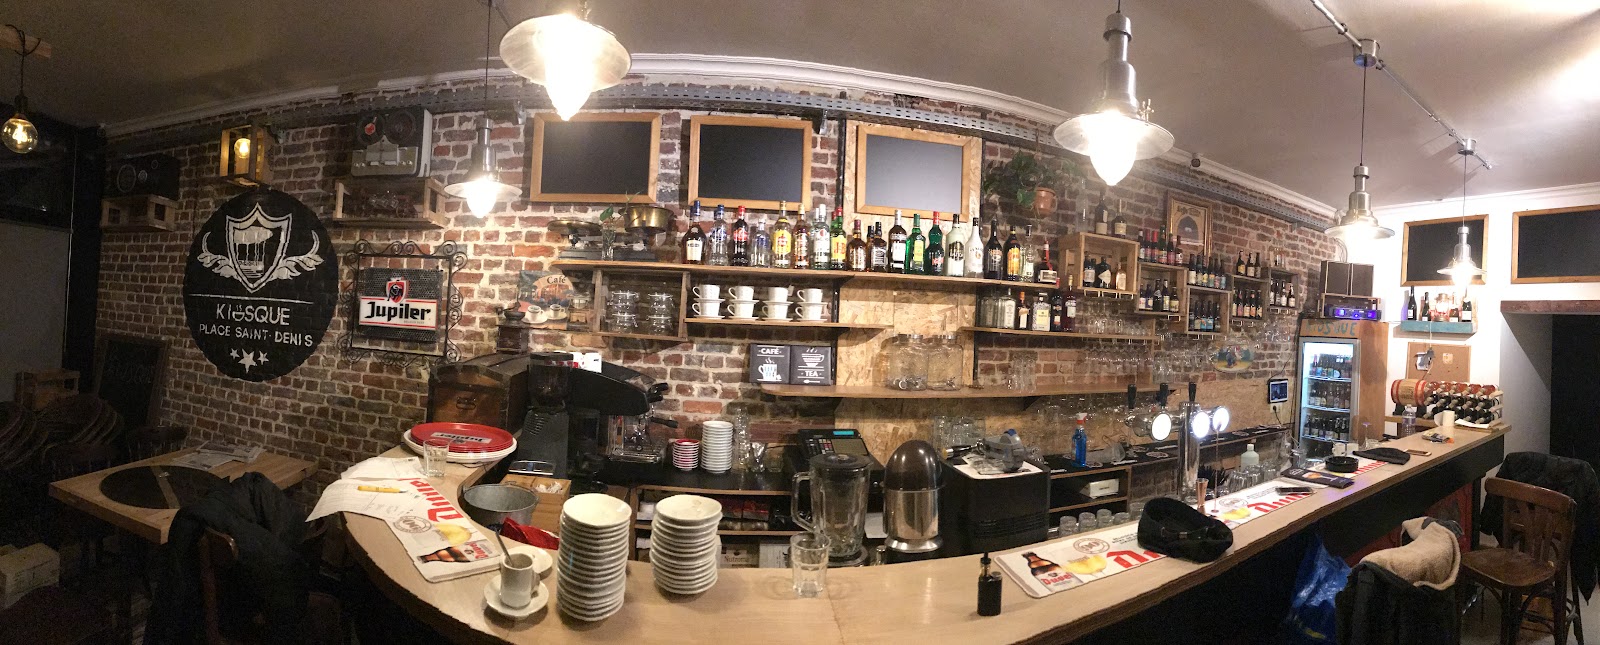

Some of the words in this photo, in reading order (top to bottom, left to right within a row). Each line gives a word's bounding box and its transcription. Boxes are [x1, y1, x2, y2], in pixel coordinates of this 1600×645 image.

[546, 275, 566, 284] Café
[216, 303, 291, 326] KIOSQUE
[364, 301, 432, 322] Jupiler
[199, 323, 231, 337] PLACE
[760, 347, 780, 355] CAFÉ
